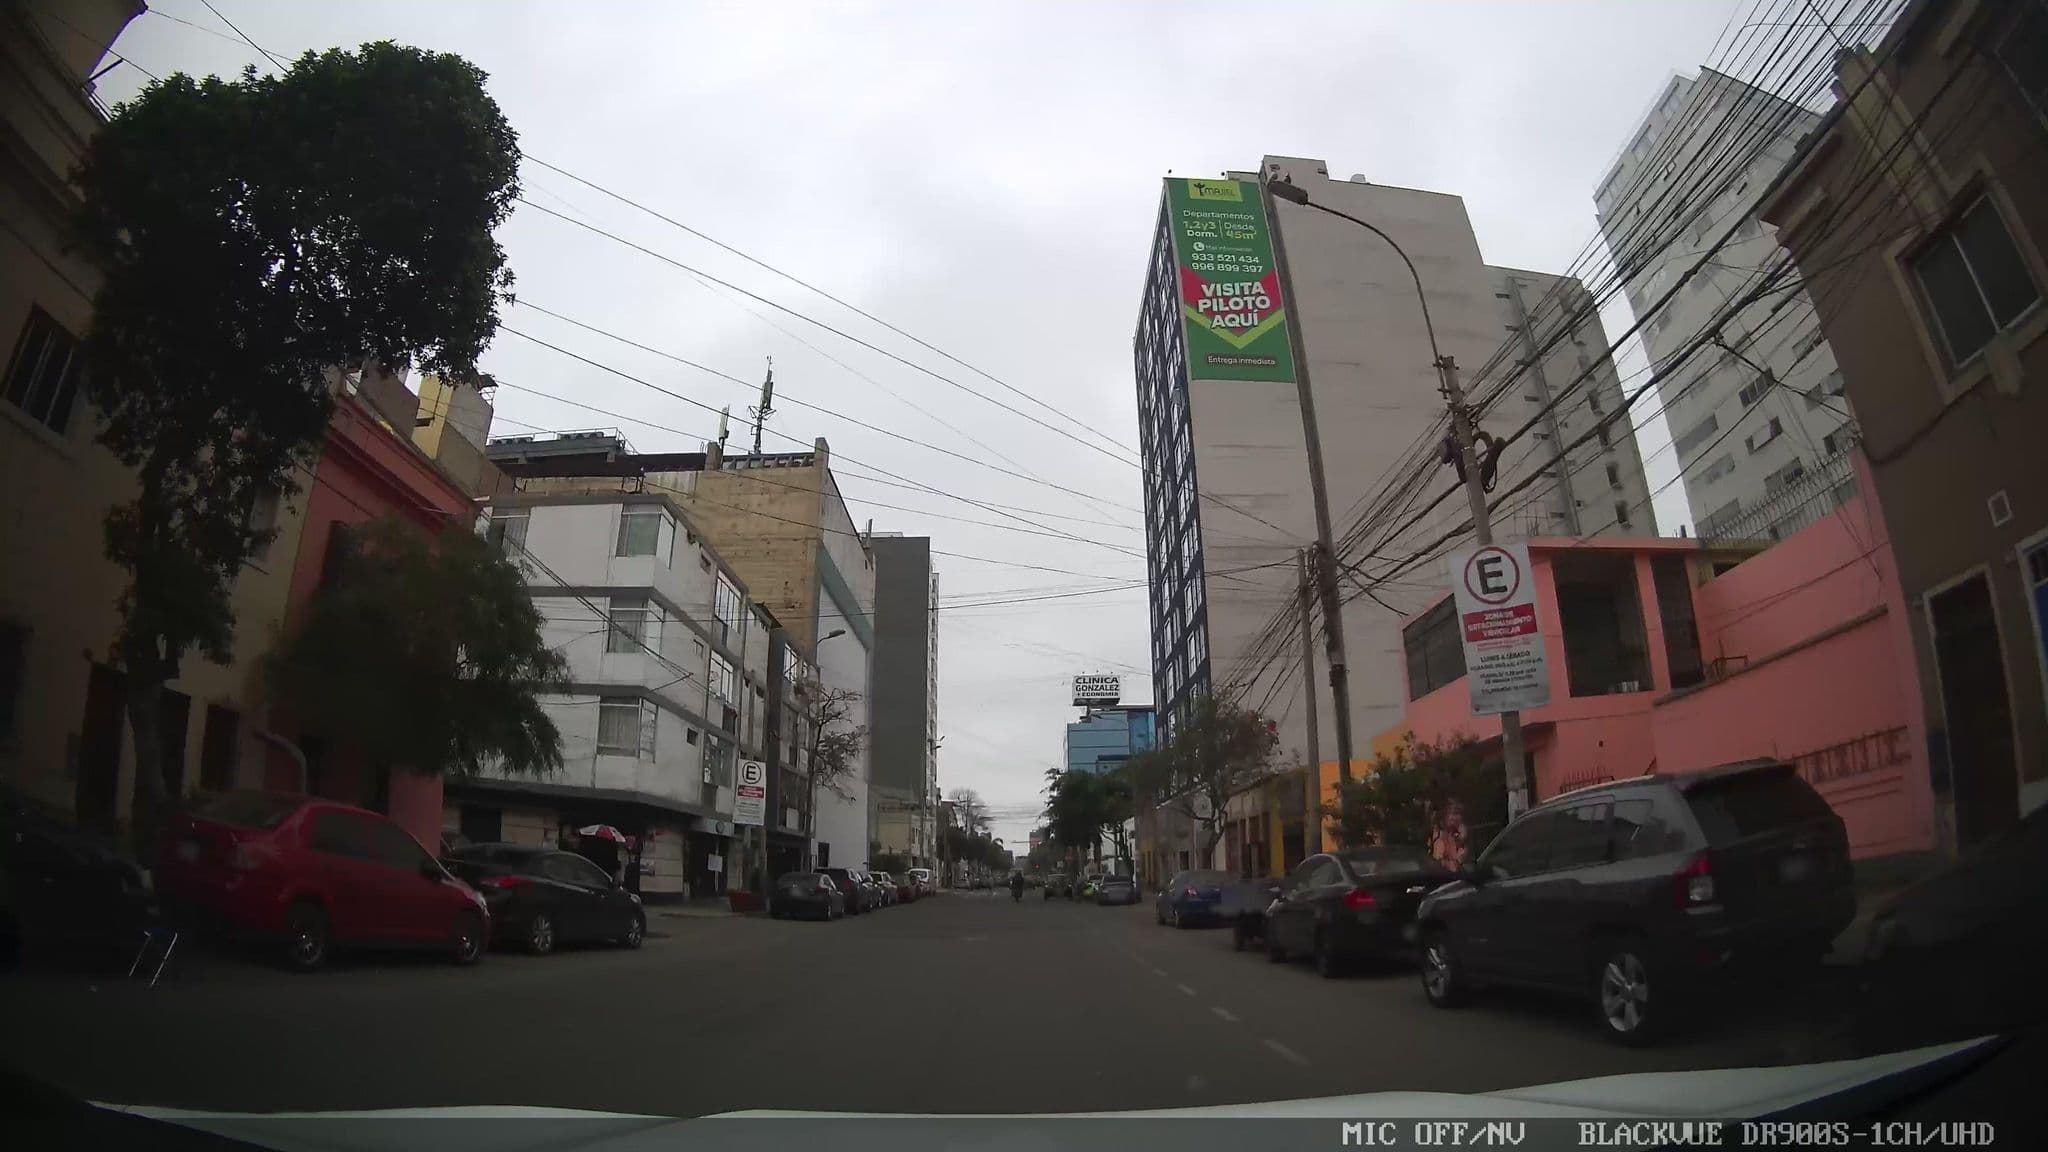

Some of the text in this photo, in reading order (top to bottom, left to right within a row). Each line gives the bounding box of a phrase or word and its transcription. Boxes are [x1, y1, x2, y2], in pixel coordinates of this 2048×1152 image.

[1183, 210, 1254, 220] Departamentos
[1224, 222, 1254, 230] Desde
[1187, 229, 1218, 238] Dorm.
[1217, 254, 1236, 262] 521
[1238, 255, 1259, 263] 434
[1217, 264, 1240, 272] 899
[1242, 265, 1263, 273] 397
[1201, 281, 1265, 297] VISITA
[1198, 296, 1271, 312] PILOTO
[1211, 310, 1258, 328] AQUÍ
[1208, 356, 1237, 364] Entrega
[1476, 556, 1508, 595] E
[746, 765, 756, 780] E
